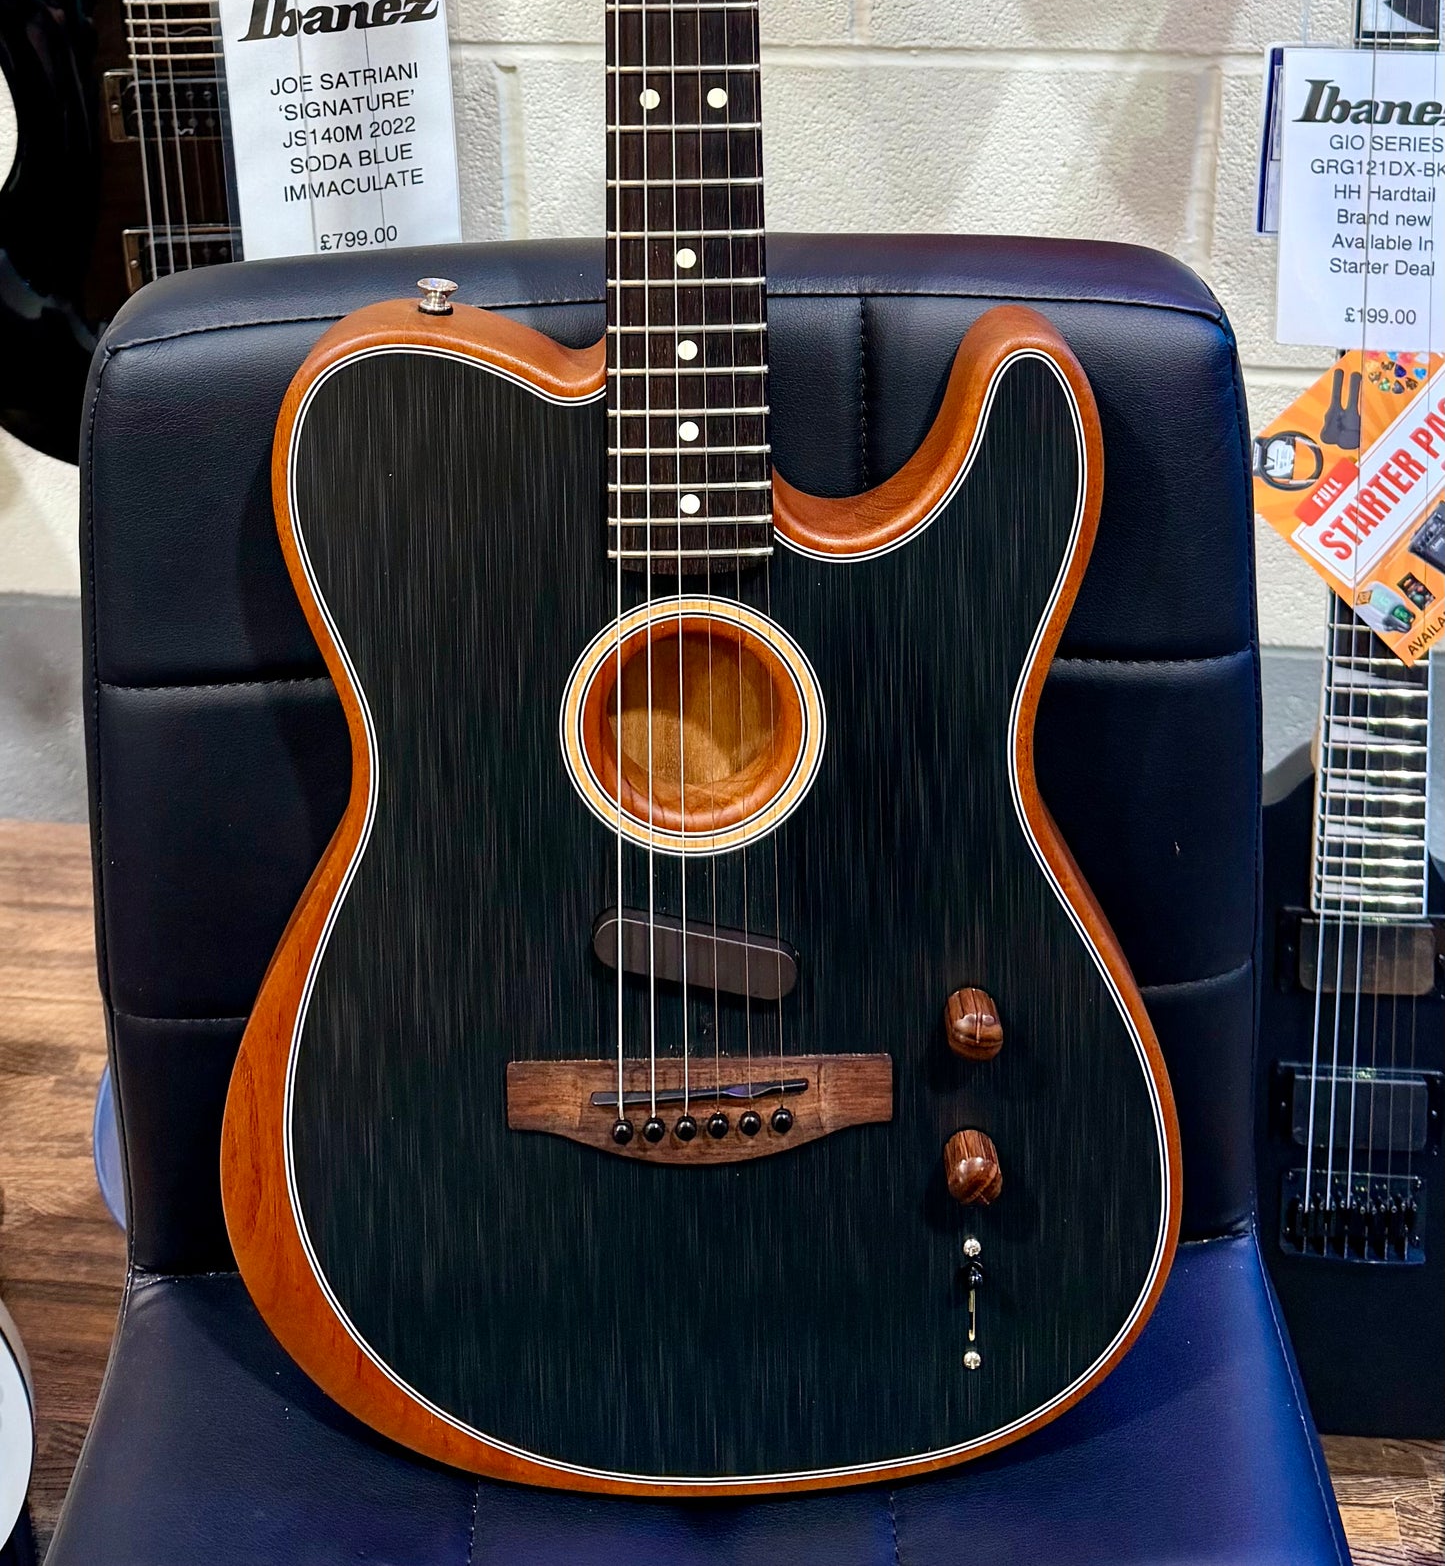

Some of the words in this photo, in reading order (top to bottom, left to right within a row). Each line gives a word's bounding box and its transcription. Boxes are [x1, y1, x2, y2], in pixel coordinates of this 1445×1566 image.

[270, 75, 312, 96] JOE
[319, 62, 419, 91] SATRIANI
[1292, 79, 1445, 126] Ibane
[282, 124, 363, 149] JS140M
[369, 116, 416, 138] 2022
[1329, 134, 1366, 151] GIO
[1371, 136, 1444, 153] SERIES
[290, 154, 353, 175] SODA
[358, 143, 413, 165] BLUE
[283, 168, 424, 203] IMMACULATE
[1334, 184, 1361, 200] HH
[1369, 186, 1436, 203] Hardtail
[1337, 209, 1389, 226] Brand
[1395, 213, 1432, 227] new
[320, 225, 398, 251] £799.00
[1332, 233, 1413, 252] Avalable
[1419, 235, 1434, 251] In
[1329, 258, 1389, 275] Starter
[1395, 260, 1435, 276] Deal
[1344, 307, 1417, 325] £199.00
[1311, 477, 1343, 508] FULL
[1318, 448, 1428, 561] STARTER
